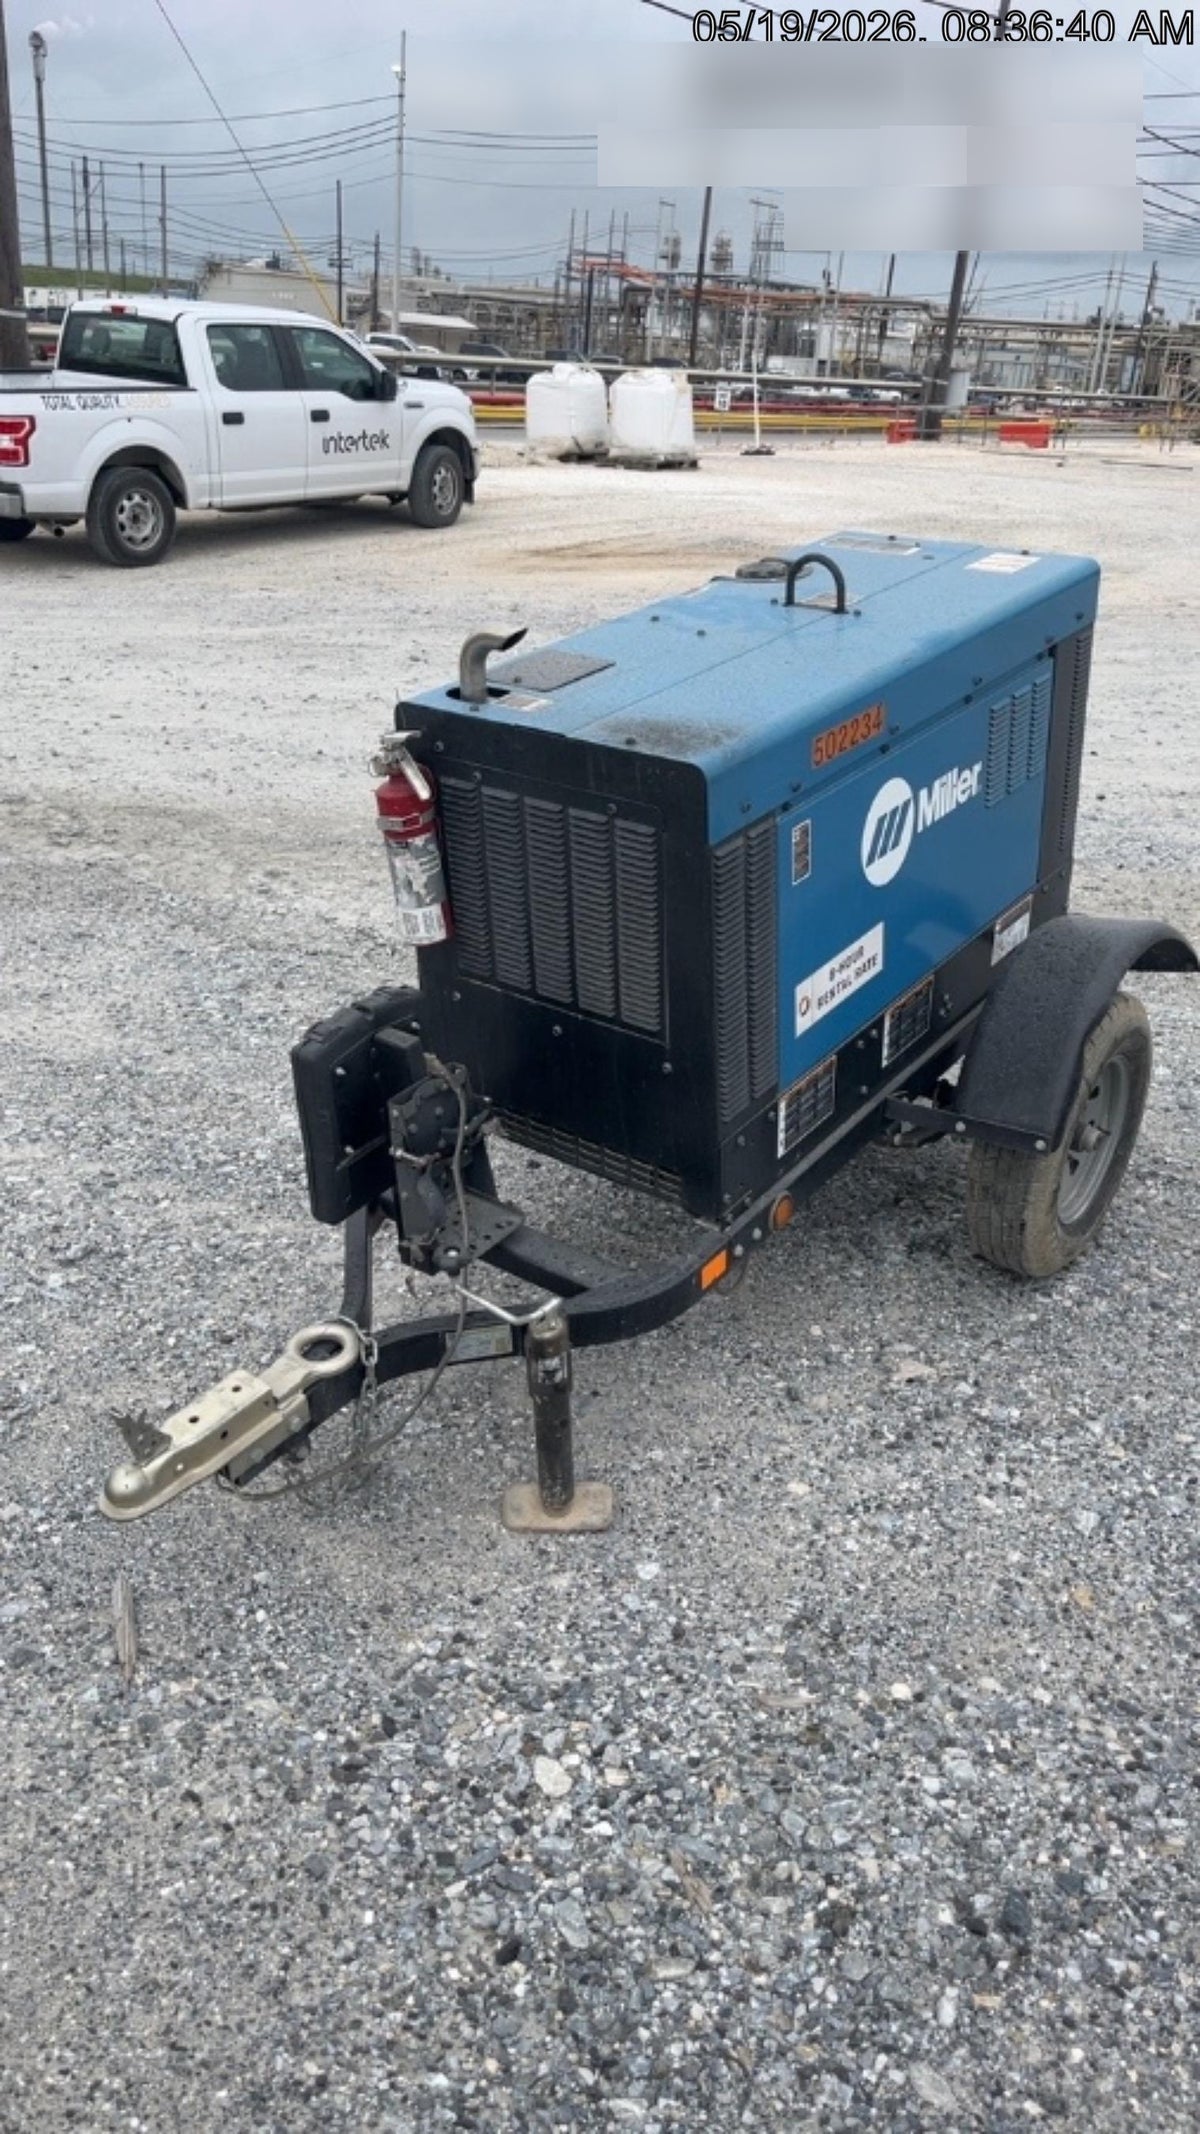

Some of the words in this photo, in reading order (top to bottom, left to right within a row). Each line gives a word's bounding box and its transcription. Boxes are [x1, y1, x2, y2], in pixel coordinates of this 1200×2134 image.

[322, 429, 390, 455] intertek
[813, 701, 883, 767] 502234
[917, 760, 983, 833] Miller
